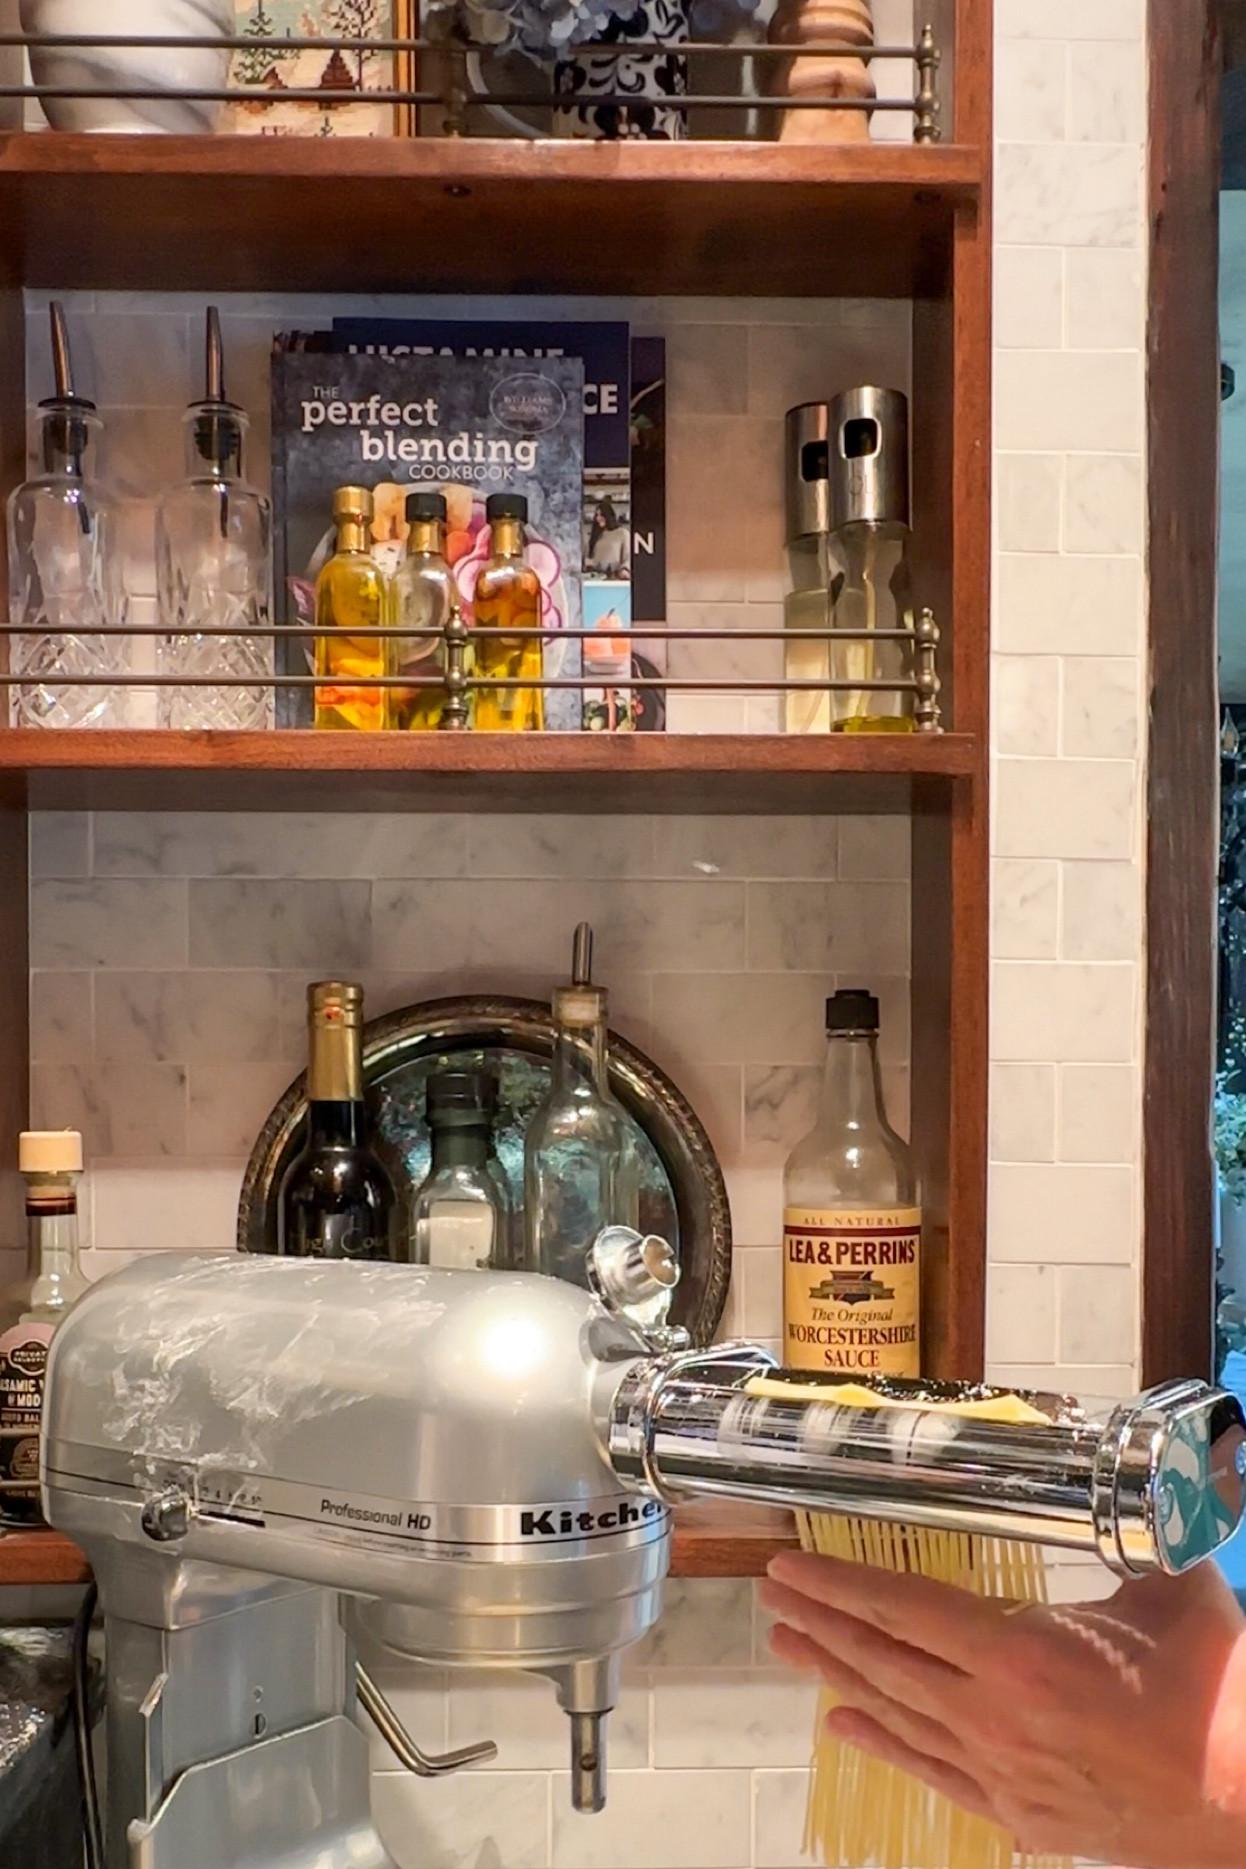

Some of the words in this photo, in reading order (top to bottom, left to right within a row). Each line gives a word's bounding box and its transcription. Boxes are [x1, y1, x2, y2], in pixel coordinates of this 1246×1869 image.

[312, 386, 340, 399] THE
[301, 394, 439, 432] perfect
[360, 429, 540, 472] blending
[409, 464, 514, 481] COOKBOOK
[803, 1216, 825, 1226] ALL
[834, 1216, 900, 1226] NATURAL
[811, 1307, 835, 1322] The
[837, 1308, 893, 1326] Original
[788, 1323, 916, 1346] WORCESTERSHIRE
[824, 1349, 880, 1368] SAUCE
[320, 1499, 403, 1527] Professional
[407, 1513, 431, 1530] HD
